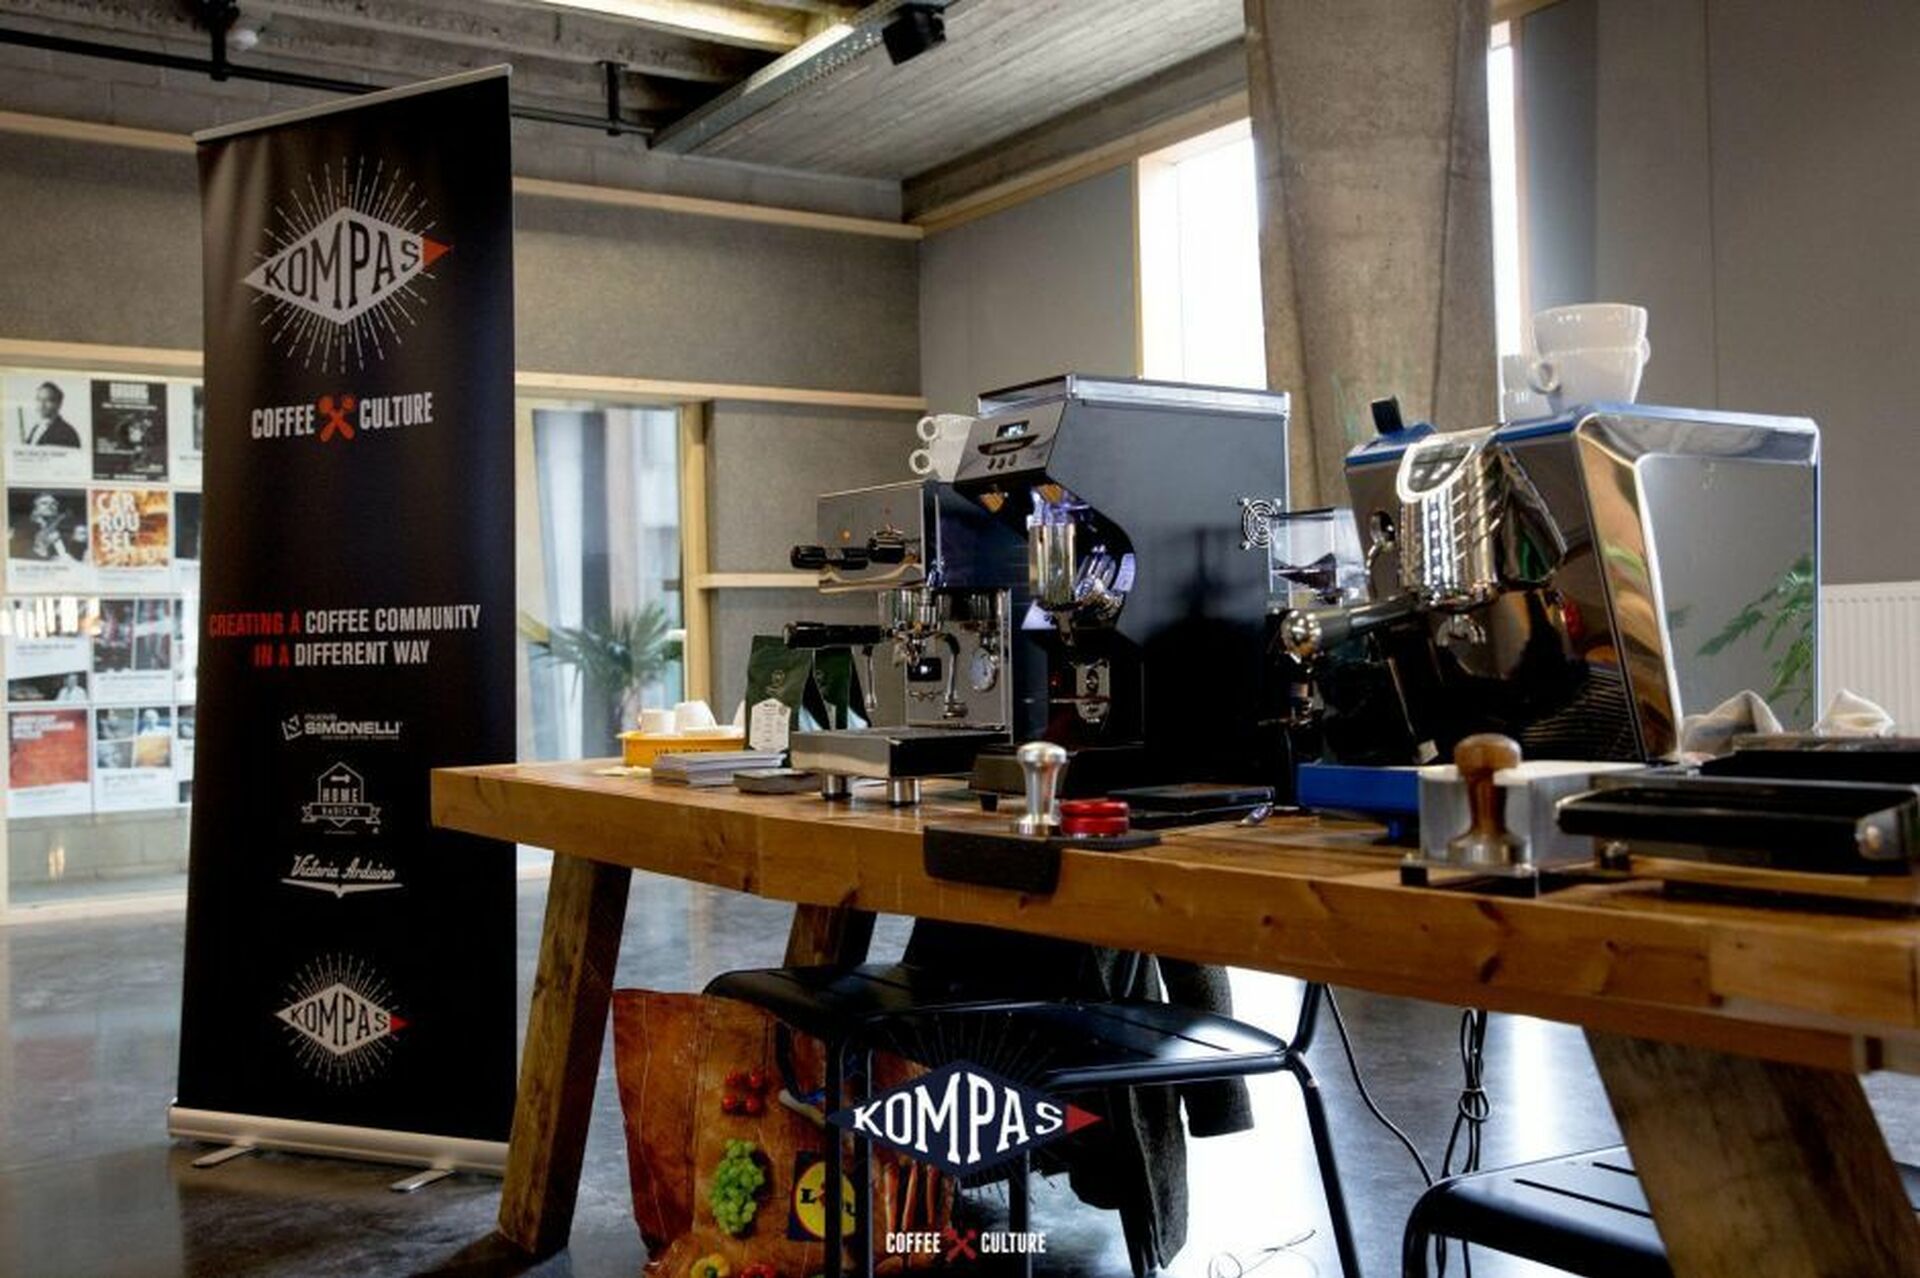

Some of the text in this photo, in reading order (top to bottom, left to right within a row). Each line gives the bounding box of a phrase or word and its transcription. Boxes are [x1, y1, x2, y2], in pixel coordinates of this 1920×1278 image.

[263, 219, 420, 310] KOMPAS
[251, 392, 434, 439] COFFEE CULTURE
[208, 604, 481, 637] CREATING A COFFEE COMMUNITY
[254, 640, 431, 667] IN A DIFFERENT WAY
[304, 721, 400, 735] SIMONELLI
[291, 990, 388, 1047] KOMPAS
